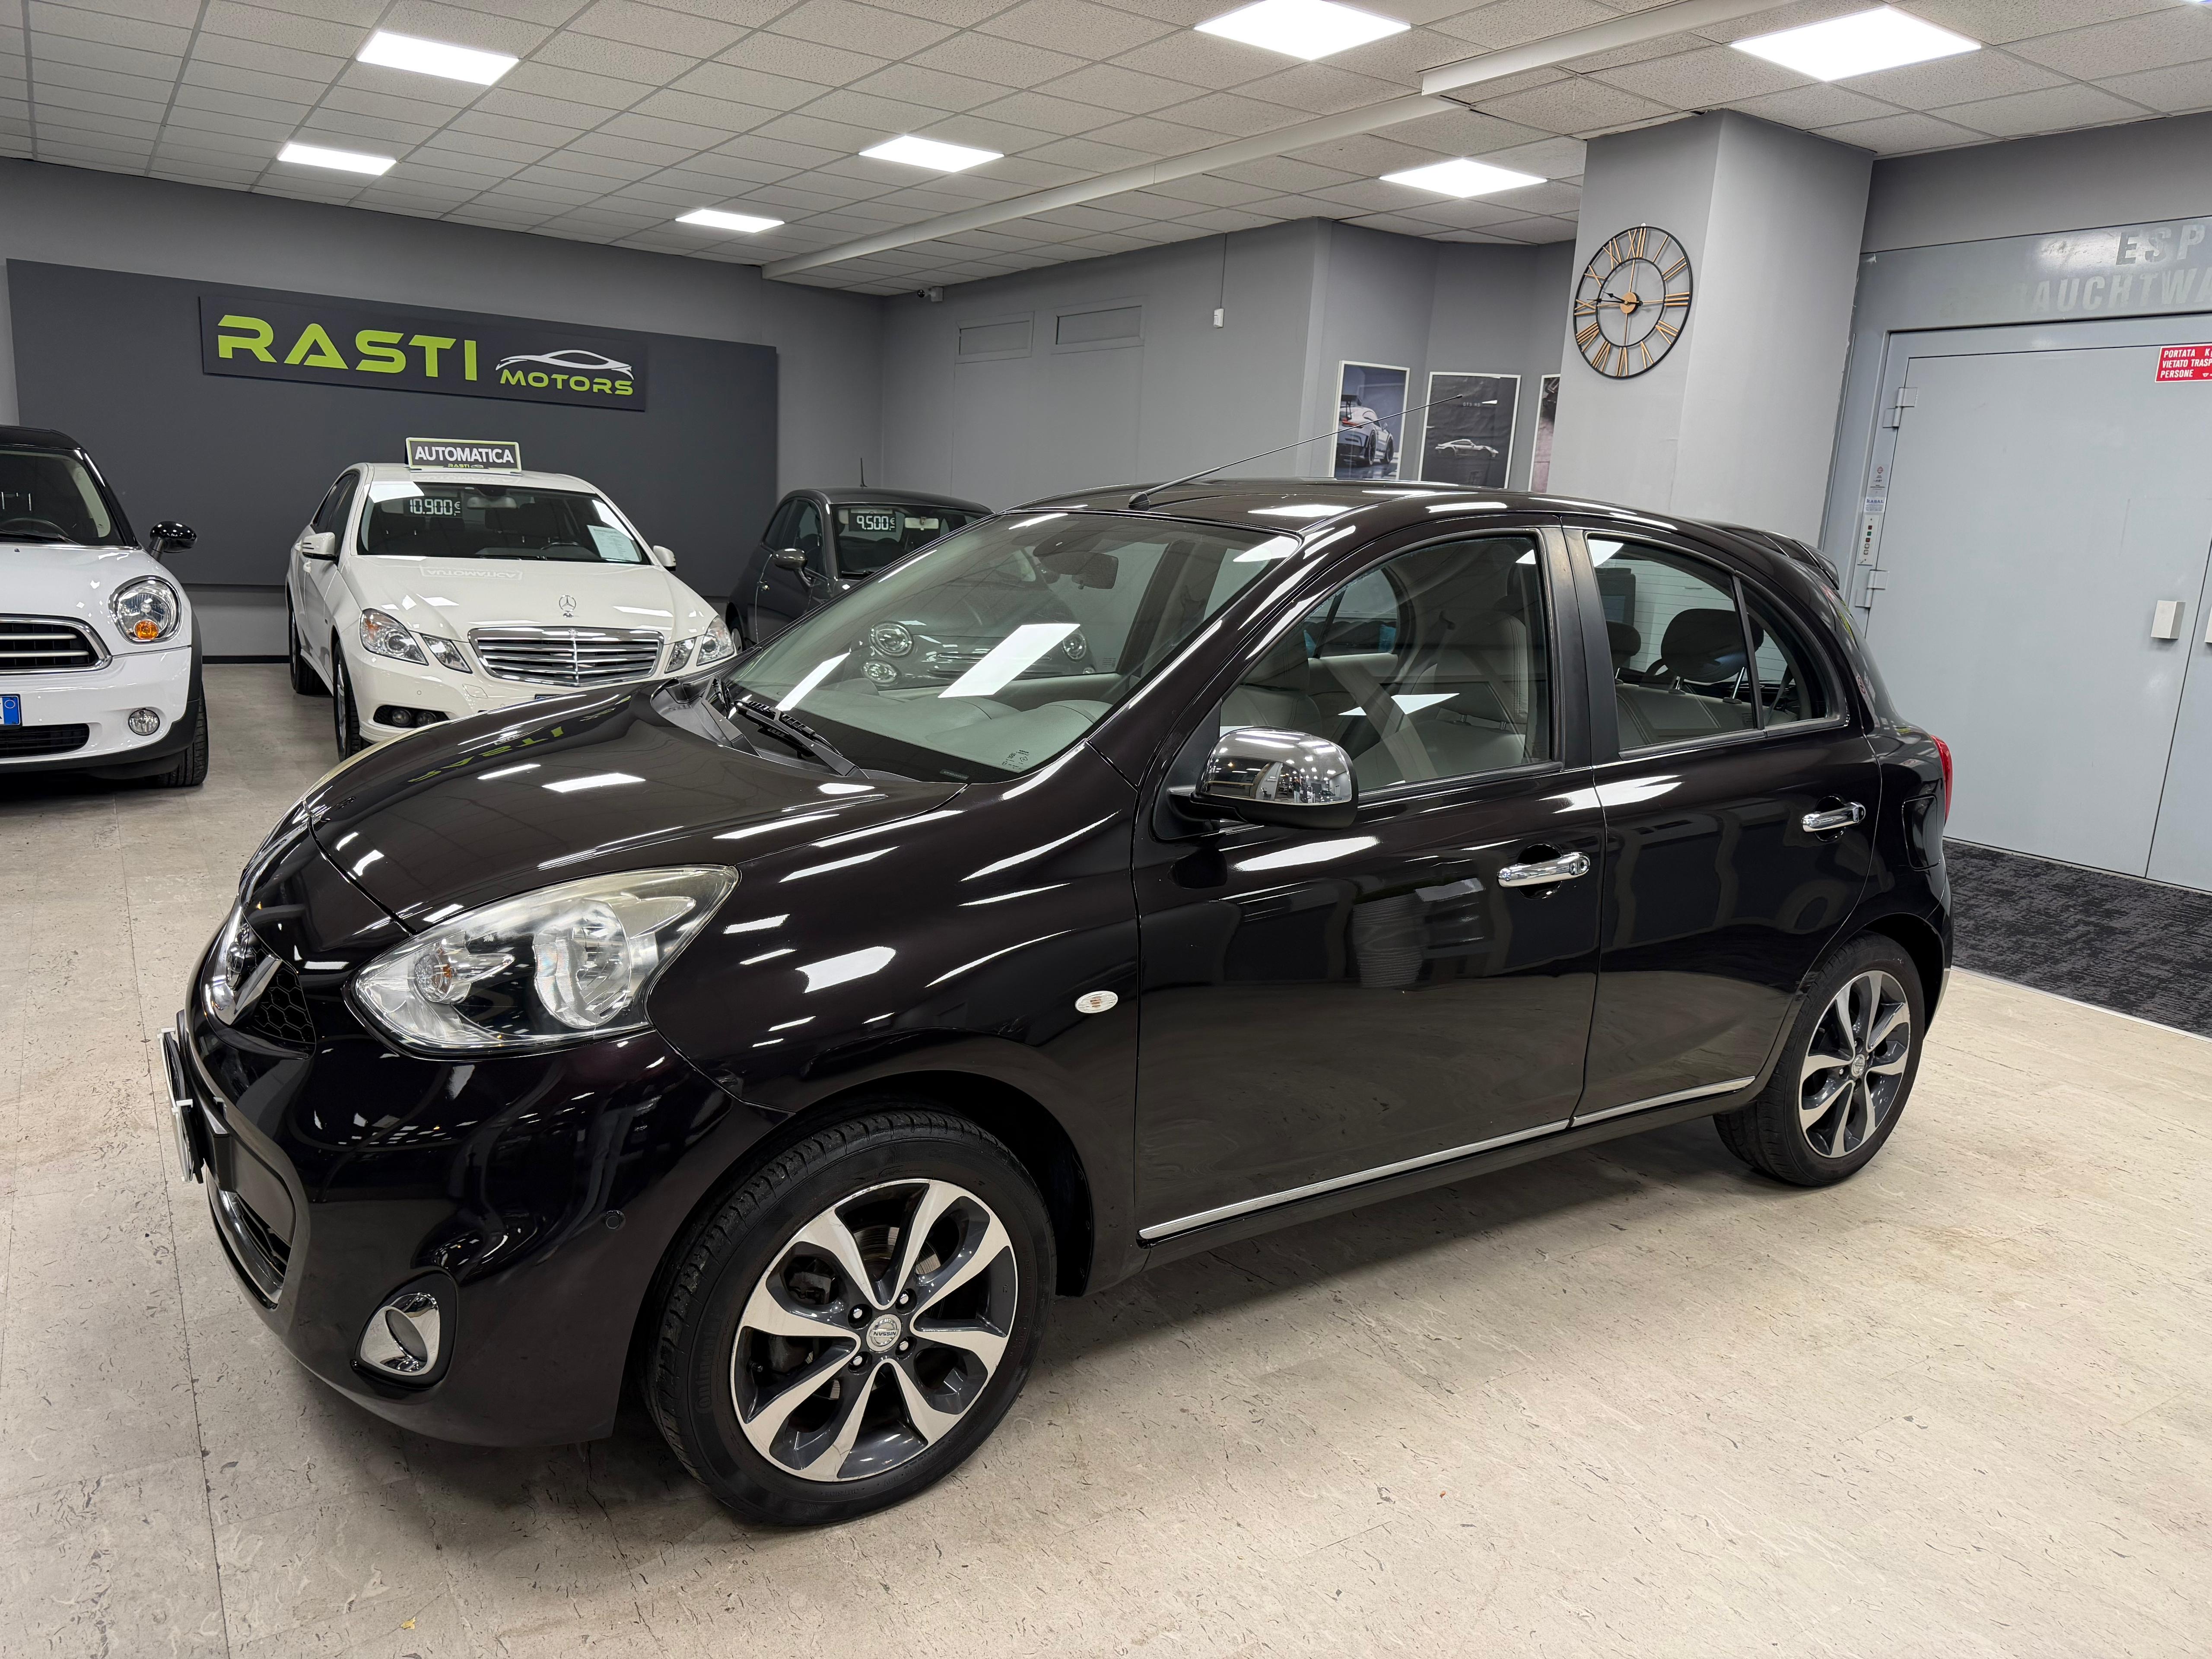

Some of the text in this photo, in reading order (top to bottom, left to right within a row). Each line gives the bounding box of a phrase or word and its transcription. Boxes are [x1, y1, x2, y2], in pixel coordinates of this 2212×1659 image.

[217, 315, 477, 381] RASTI
[2164, 349, 2195, 358] PORTATA
[2162, 359, 2188, 368] VIETATO
[2160, 369, 2194, 378] PERSONE
[500, 369, 634, 396] MOTORS
[415, 446, 514, 464] AUTOMATICA
